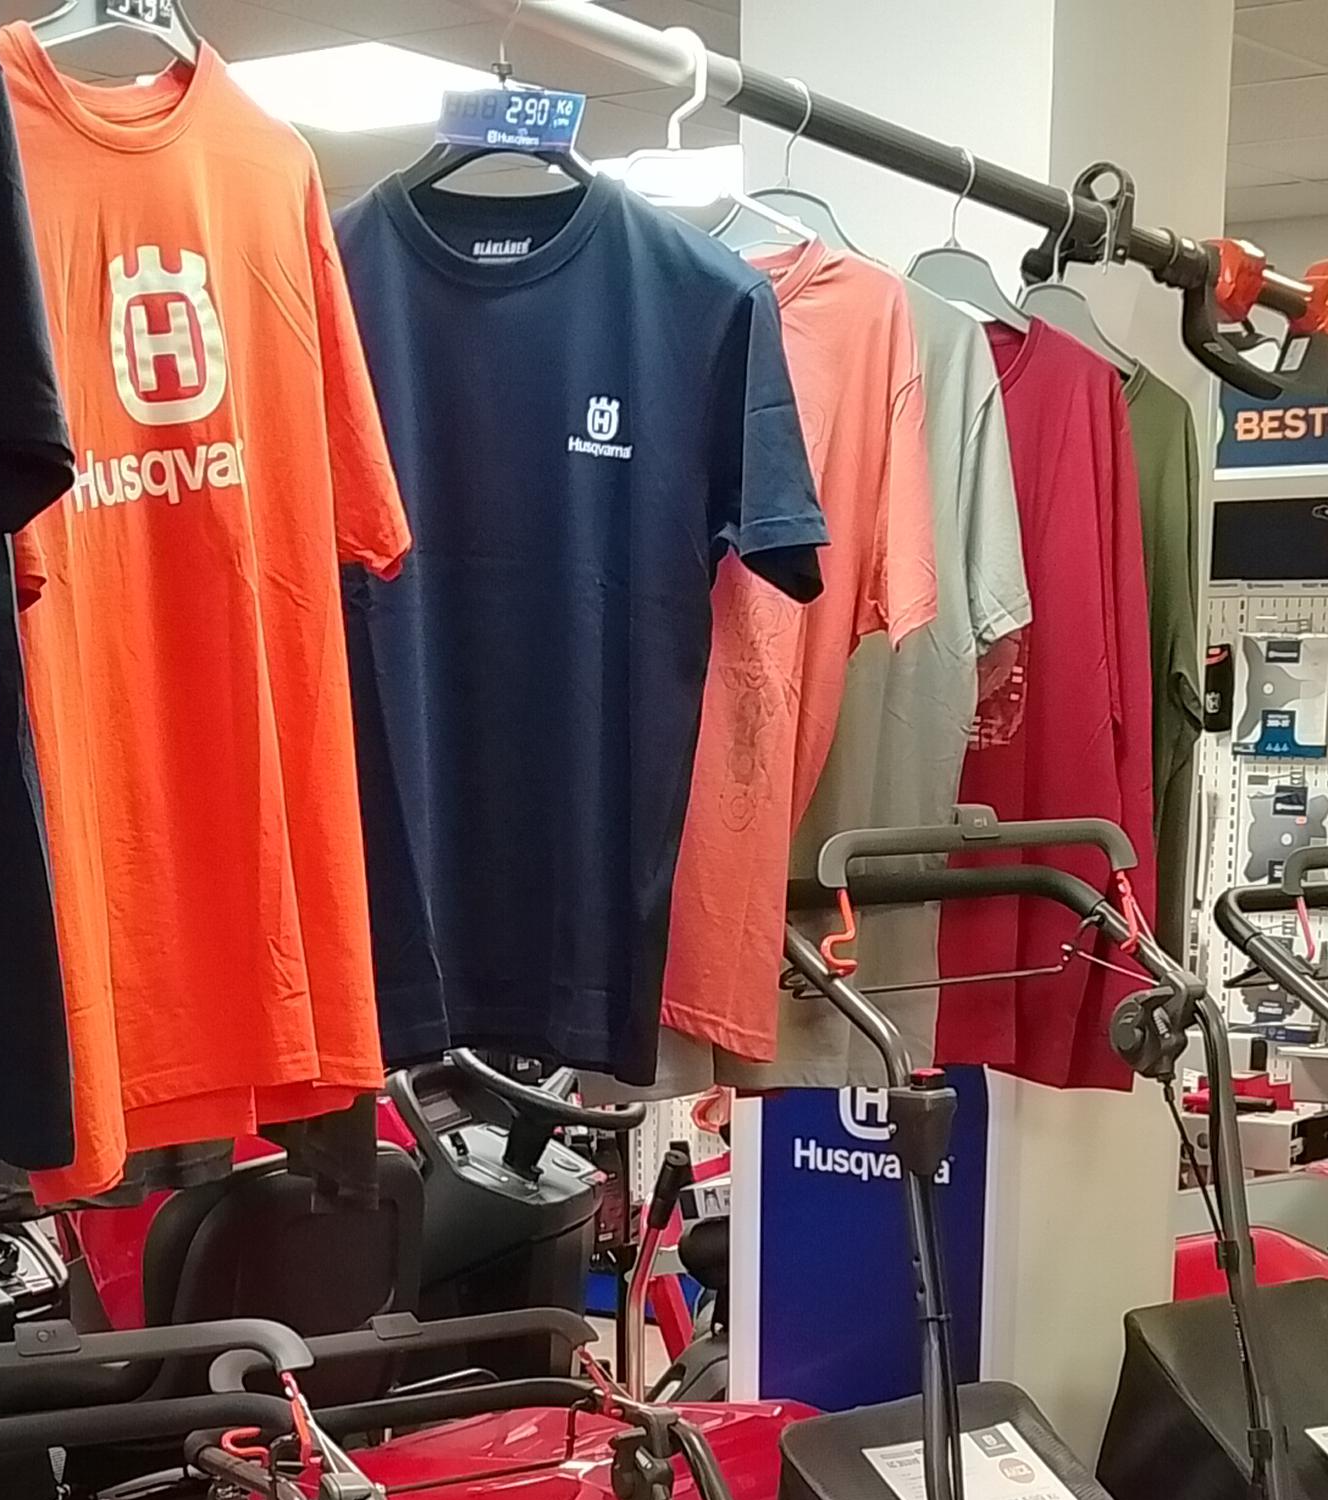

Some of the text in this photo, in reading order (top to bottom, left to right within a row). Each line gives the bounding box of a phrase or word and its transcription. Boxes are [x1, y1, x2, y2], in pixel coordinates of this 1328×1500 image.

[506, 96, 549, 126] 290
[568, 435, 632, 459] Husqvarna
[794, 1137, 950, 1184] Husqvaa
